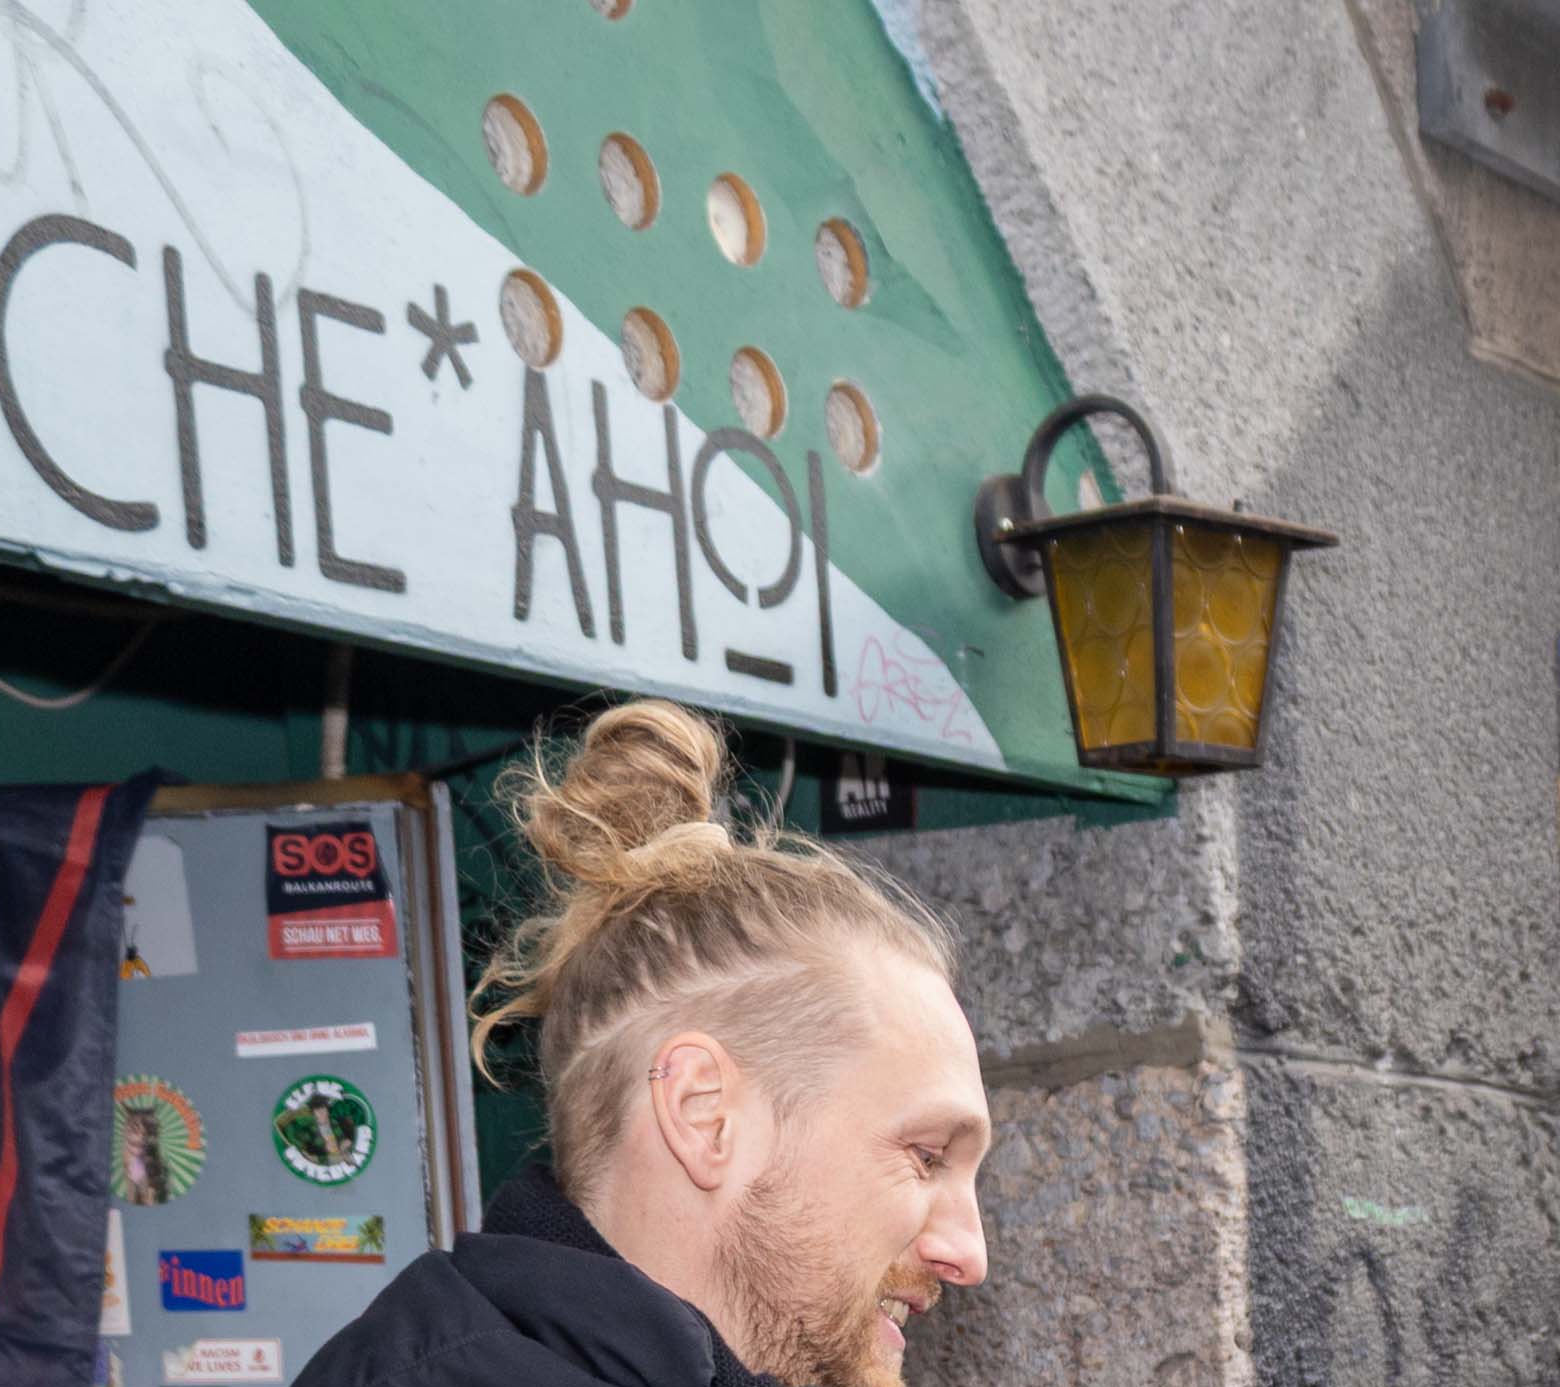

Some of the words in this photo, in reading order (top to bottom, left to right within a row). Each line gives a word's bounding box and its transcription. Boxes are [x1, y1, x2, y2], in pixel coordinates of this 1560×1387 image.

[508, 370, 840, 698] AHOI
[271, 831, 377, 879] SOS
[280, 879, 376, 893] BALKANROUTE
[282, 926, 323, 945] SCHAU
[325, 926, 350, 943] NET
